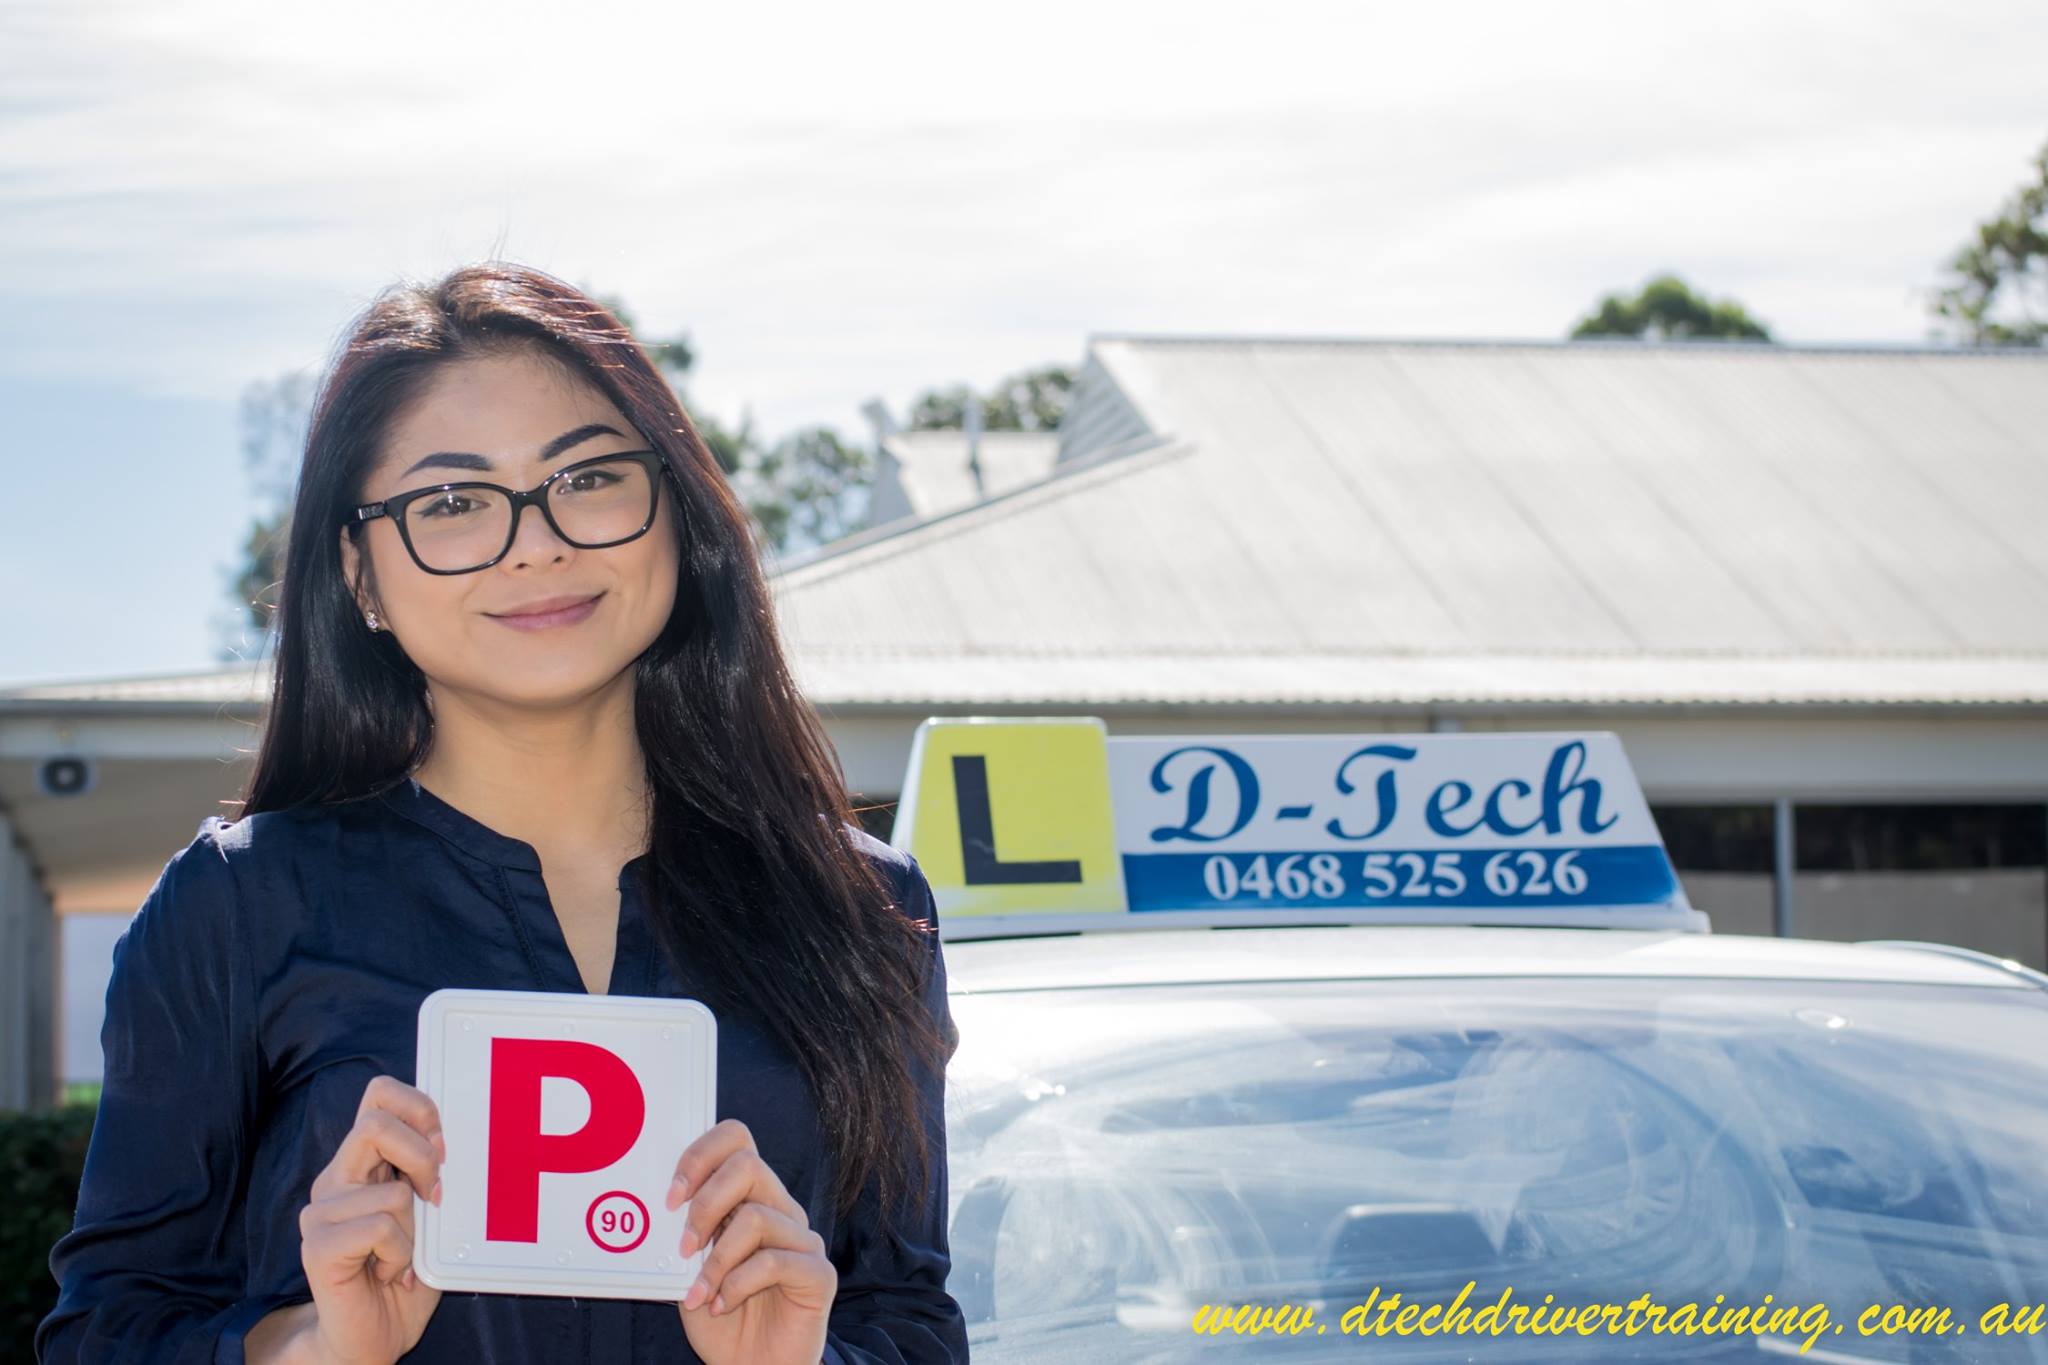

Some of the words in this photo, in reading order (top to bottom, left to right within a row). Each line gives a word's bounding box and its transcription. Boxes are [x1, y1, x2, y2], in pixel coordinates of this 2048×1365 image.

[951, 755, 1083, 886] L
[1149, 740, 1619, 843] D-Tech
[1203, 856, 1345, 899] 0468
[1363, 854, 1466, 898] 525
[1484, 851, 1588, 896] 626
[485, 1037, 646, 1244] P
[601, 1210, 636, 1234] 90
